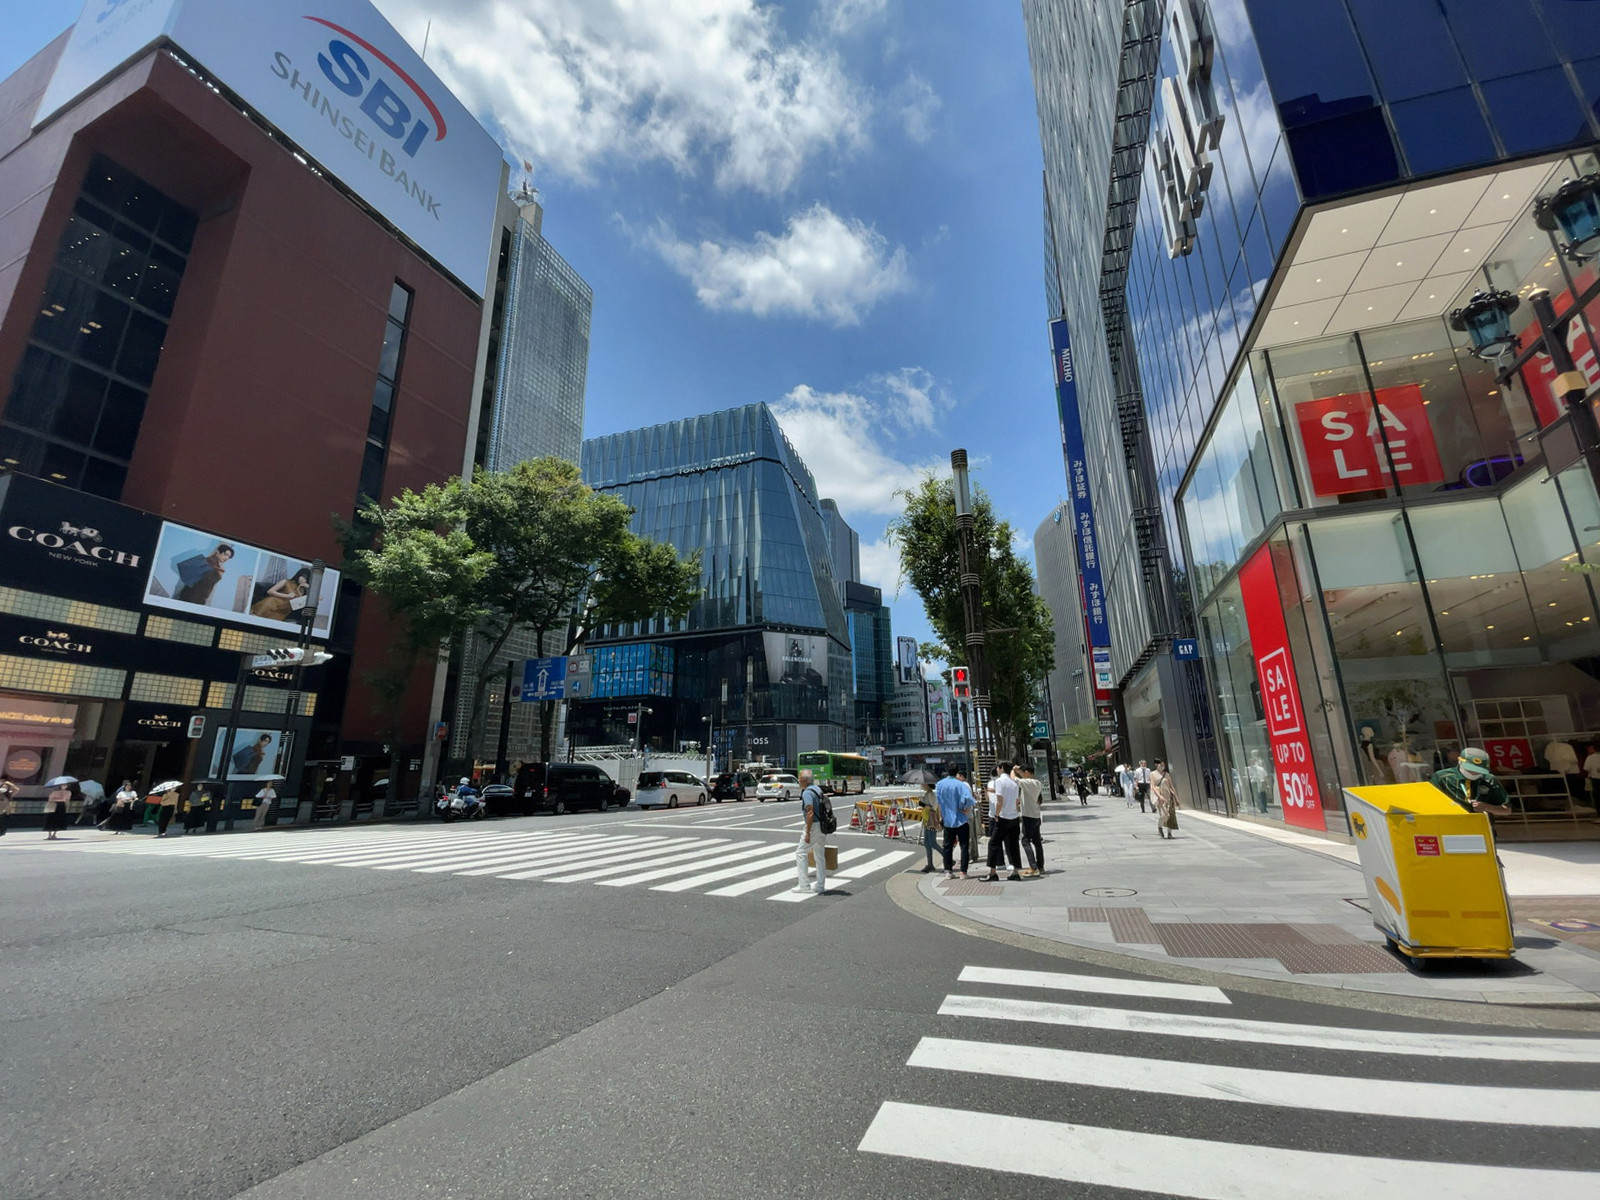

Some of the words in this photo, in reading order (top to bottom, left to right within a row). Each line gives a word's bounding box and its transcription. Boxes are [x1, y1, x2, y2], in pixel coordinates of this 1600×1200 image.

[318, 39, 431, 158] SBI
[270, 50, 376, 160] SHINSEI
[379, 149, 443, 220] BANK
[1061, 348, 1073, 383] MIZUHO
[1321, 402, 1407, 442] SA
[1332, 439, 1413, 480] LE
[1073, 460, 1087, 499] みずほ証券
[8, 525, 141, 568] COACH
[1080, 512, 1097, 569] みずほ信託銀行
[48, 551, 72, 561] NEW
[74, 558, 99, 568] YORK
[1089, 583, 1104, 624] みずほ銀行
[18, 635, 93, 653] COACH
[1178, 644, 1194, 656] GAP
[250, 668, 294, 681] OACH
[599, 664, 644, 684] SALE
[1266, 665, 1286, 692] SA
[138, 718, 181, 728] COACH
[1272, 694, 1291, 721] LE
[1276, 744, 1289, 764] UP
[1290, 741, 1305, 763] TO
[1282, 772, 1313, 808] 50%
[1306, 799, 1315, 809] OFF
